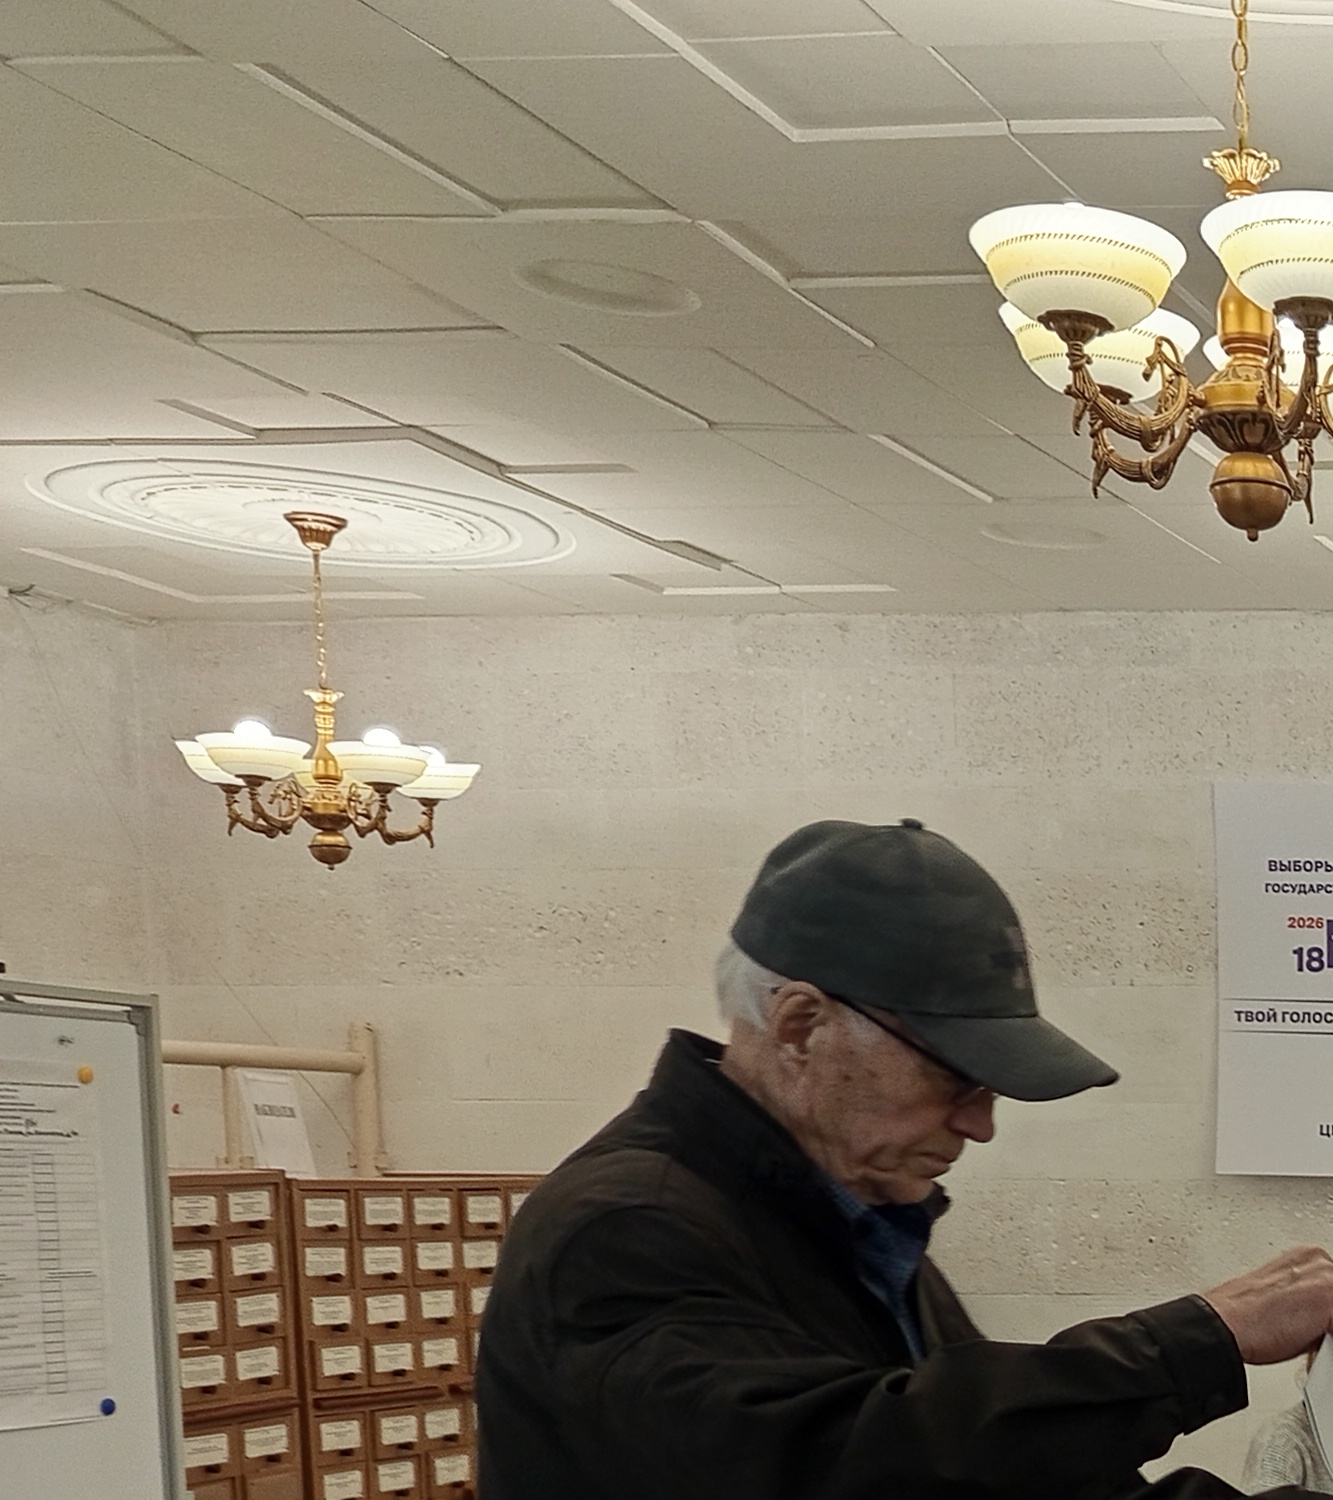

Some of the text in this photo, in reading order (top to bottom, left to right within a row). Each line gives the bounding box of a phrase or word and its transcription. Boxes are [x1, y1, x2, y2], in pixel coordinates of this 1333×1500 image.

[1287, 917, 1324, 929] 2026
[1292, 947, 1325, 972] 18
[1234, 1008, 1278, 1023] ТВОЙ
[1281, 1012, 1333, 1024] ГОЛОС
